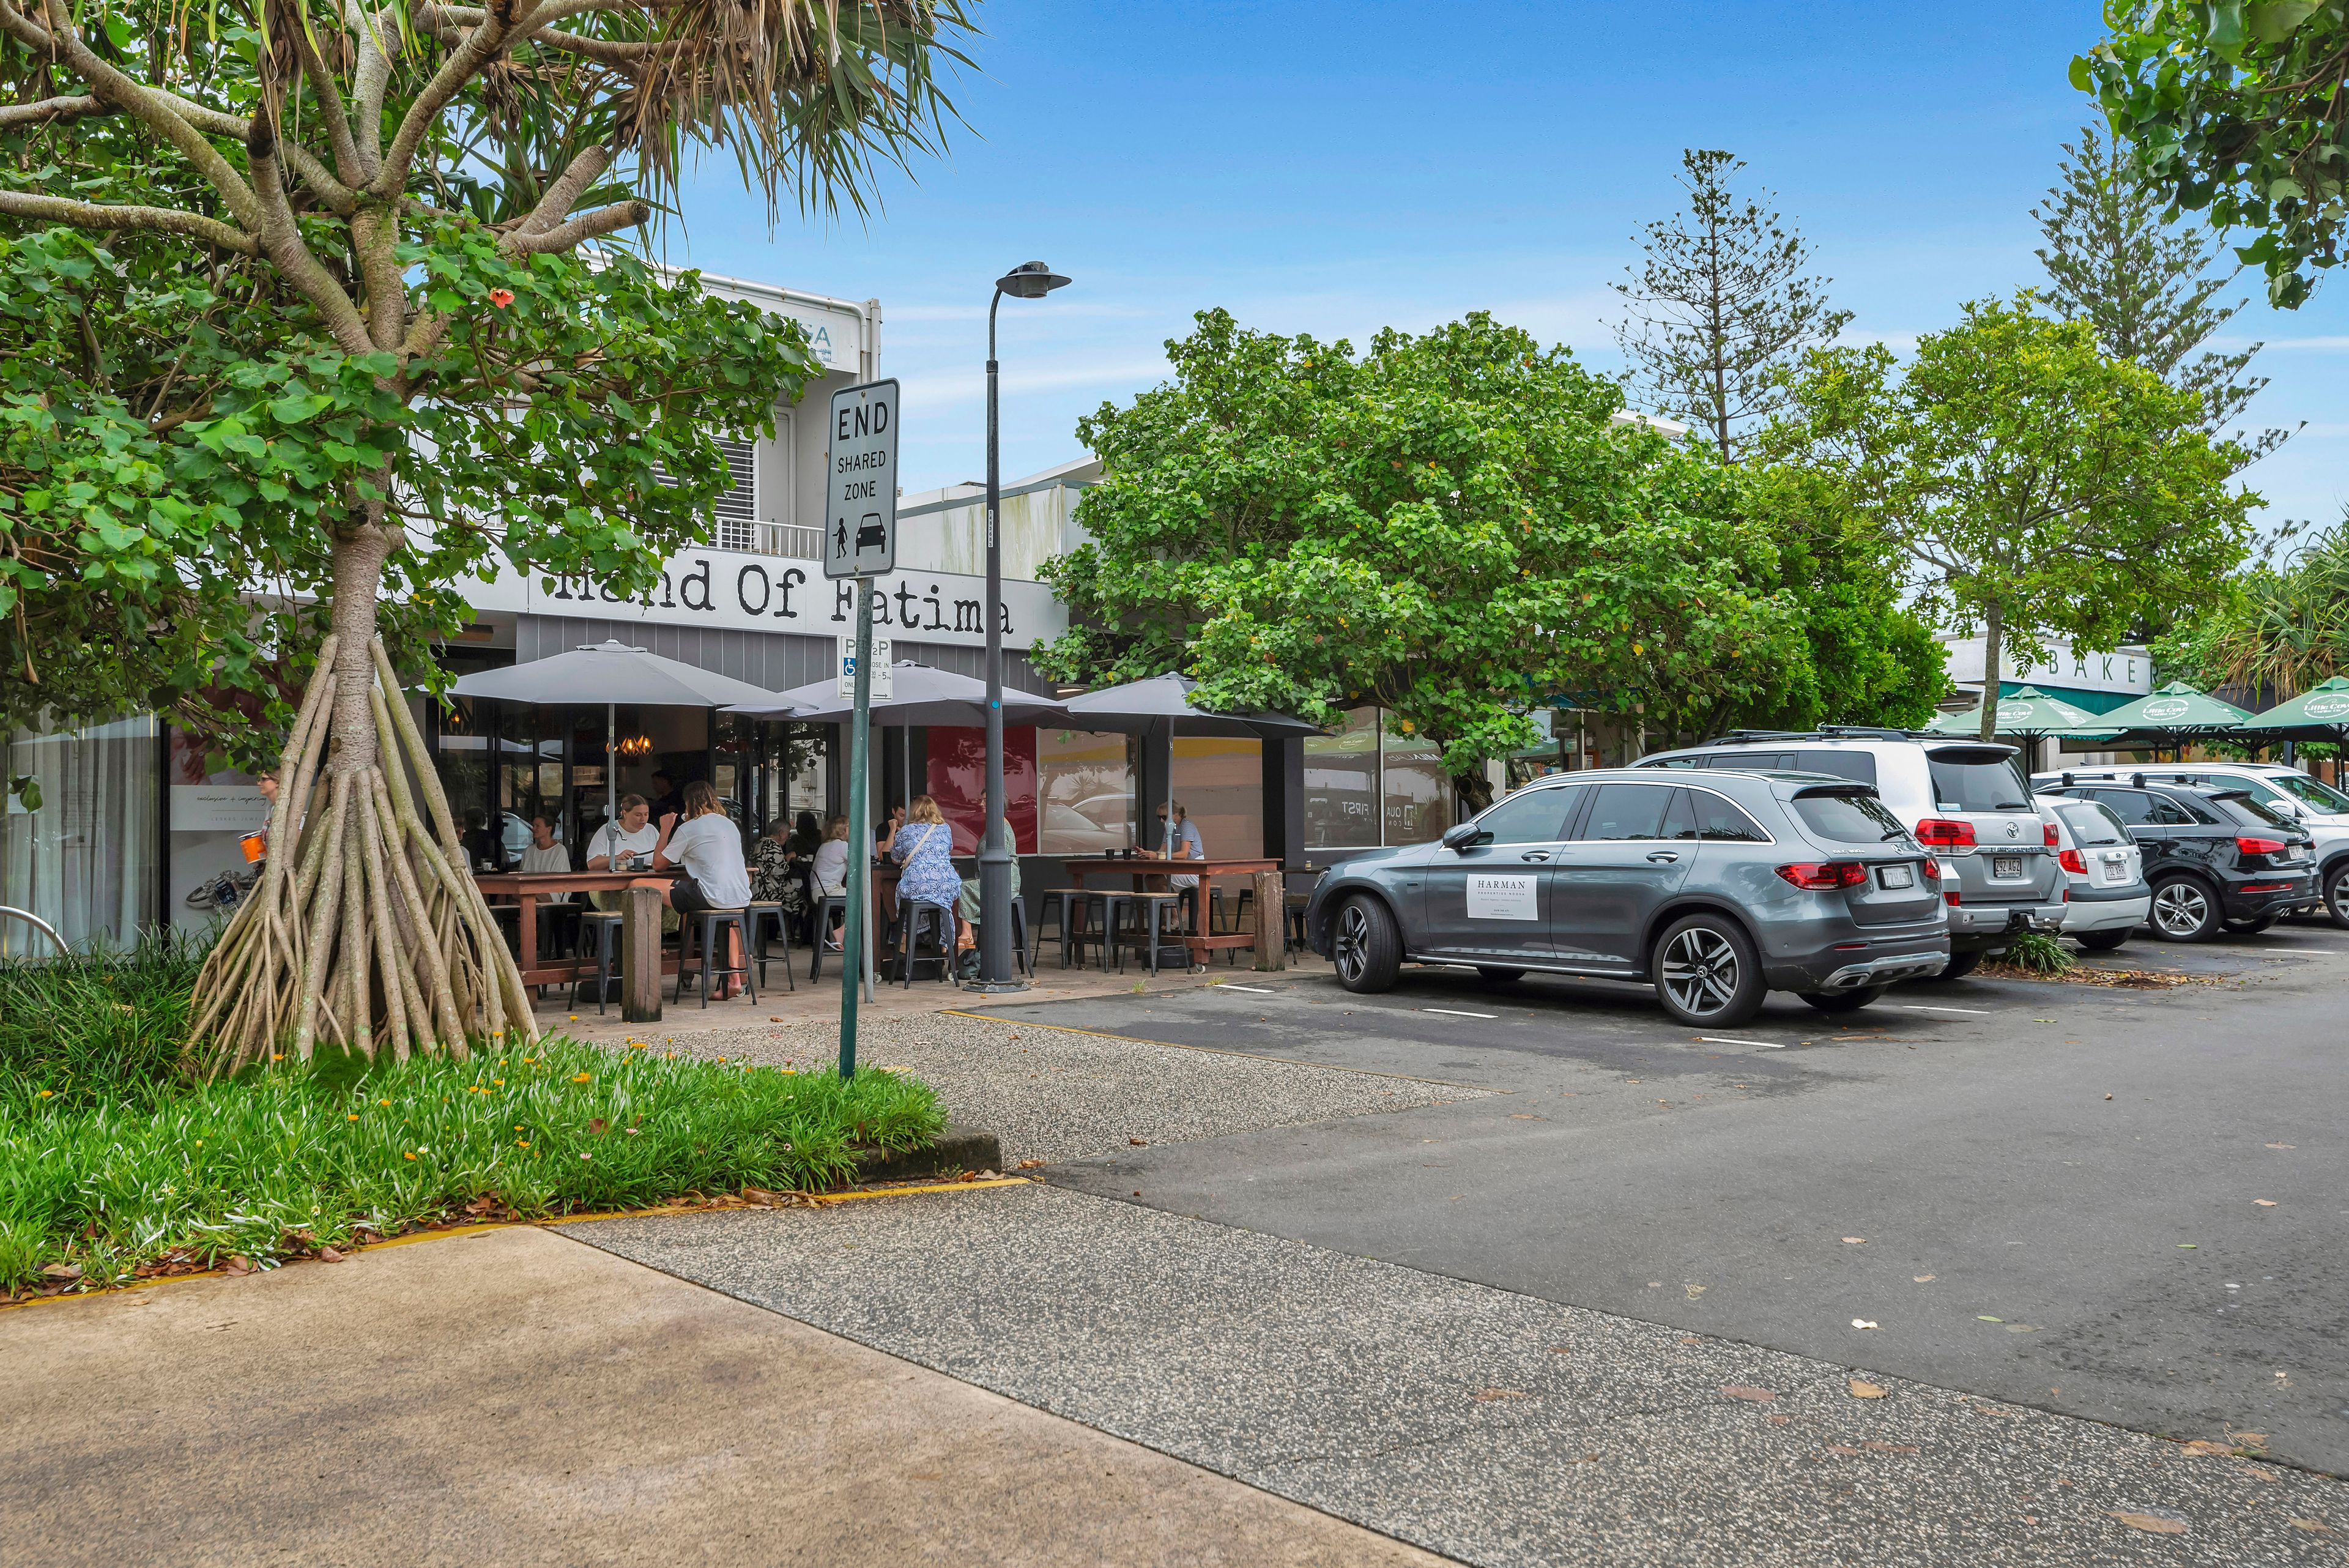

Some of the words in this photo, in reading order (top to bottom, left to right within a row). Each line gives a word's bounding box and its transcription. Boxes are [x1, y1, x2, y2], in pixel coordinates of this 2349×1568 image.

[838, 401, 888, 440] END
[837, 450, 886, 474] SHARED
[844, 480, 876, 500] ZONE
[737, 564, 806, 619] Of
[831, 579, 1014, 634] Fatima
[846, 639, 856, 653] P
[2049, 649, 2159, 684] BAKER
[238, 796, 267, 806] inspiring
[1478, 880, 1525, 889] HARMAN
